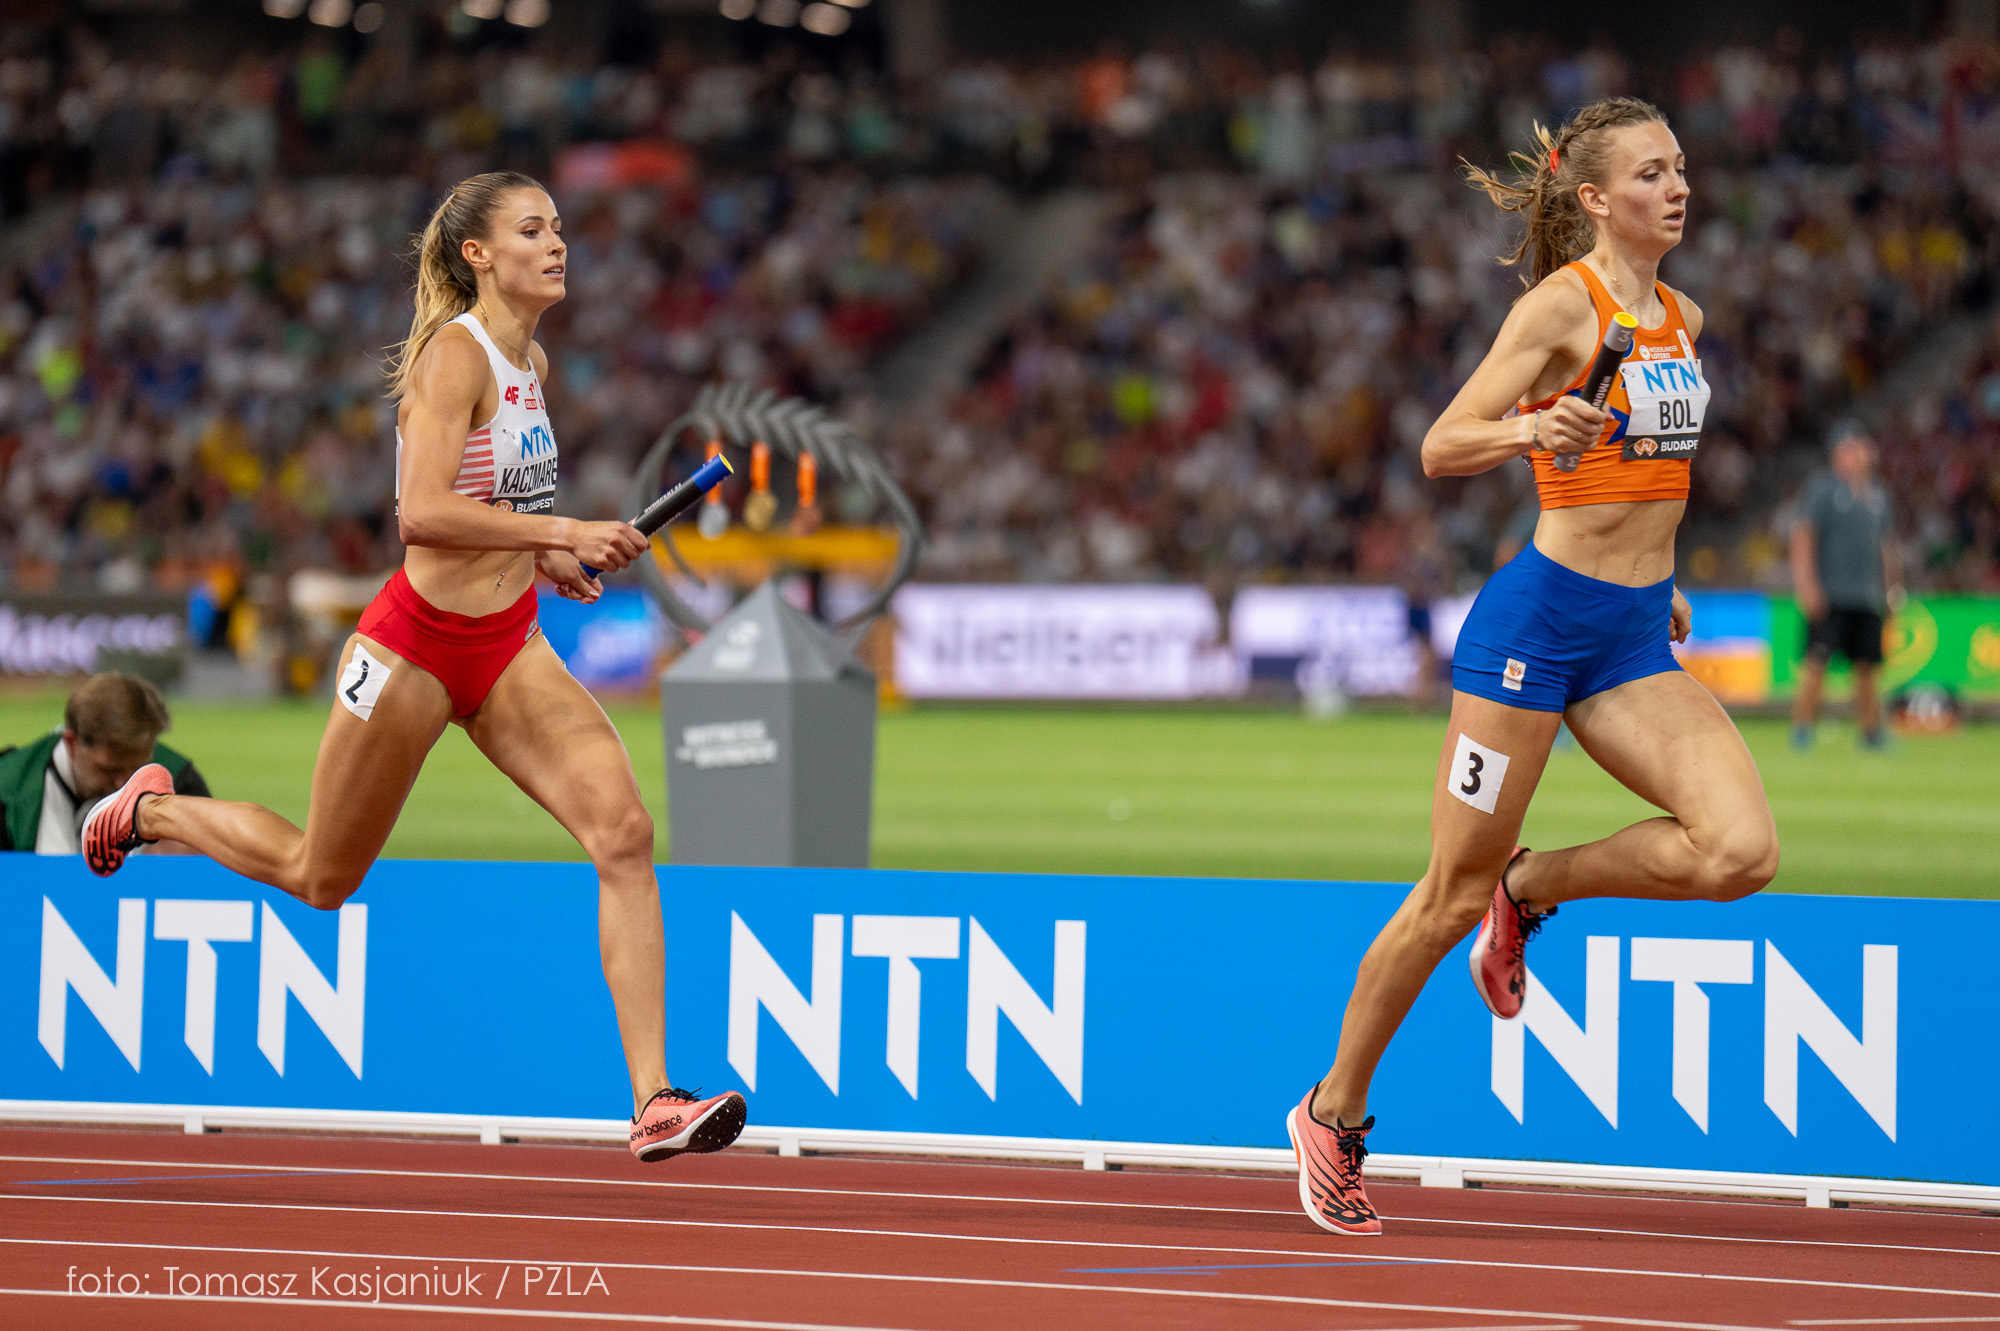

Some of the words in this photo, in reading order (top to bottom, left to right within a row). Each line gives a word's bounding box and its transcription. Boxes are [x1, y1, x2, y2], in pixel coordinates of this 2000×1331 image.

[1592, 384, 1609, 407] MON
[1641, 361, 1700, 394] NTN
[1659, 399, 1698, 430] BOL
[521, 423, 553, 461] NTN
[516, 497, 555, 513] BUDAPEST
[345, 660, 369, 704] 2
[1460, 752, 1484, 796] 3
[38, 895, 368, 1080] NTN
[727, 909, 1087, 1107] NTN
[1491, 935, 1898, 1143] NTN
[631, 1129, 644, 1142] ew
[644, 1115, 683, 1136] balance
